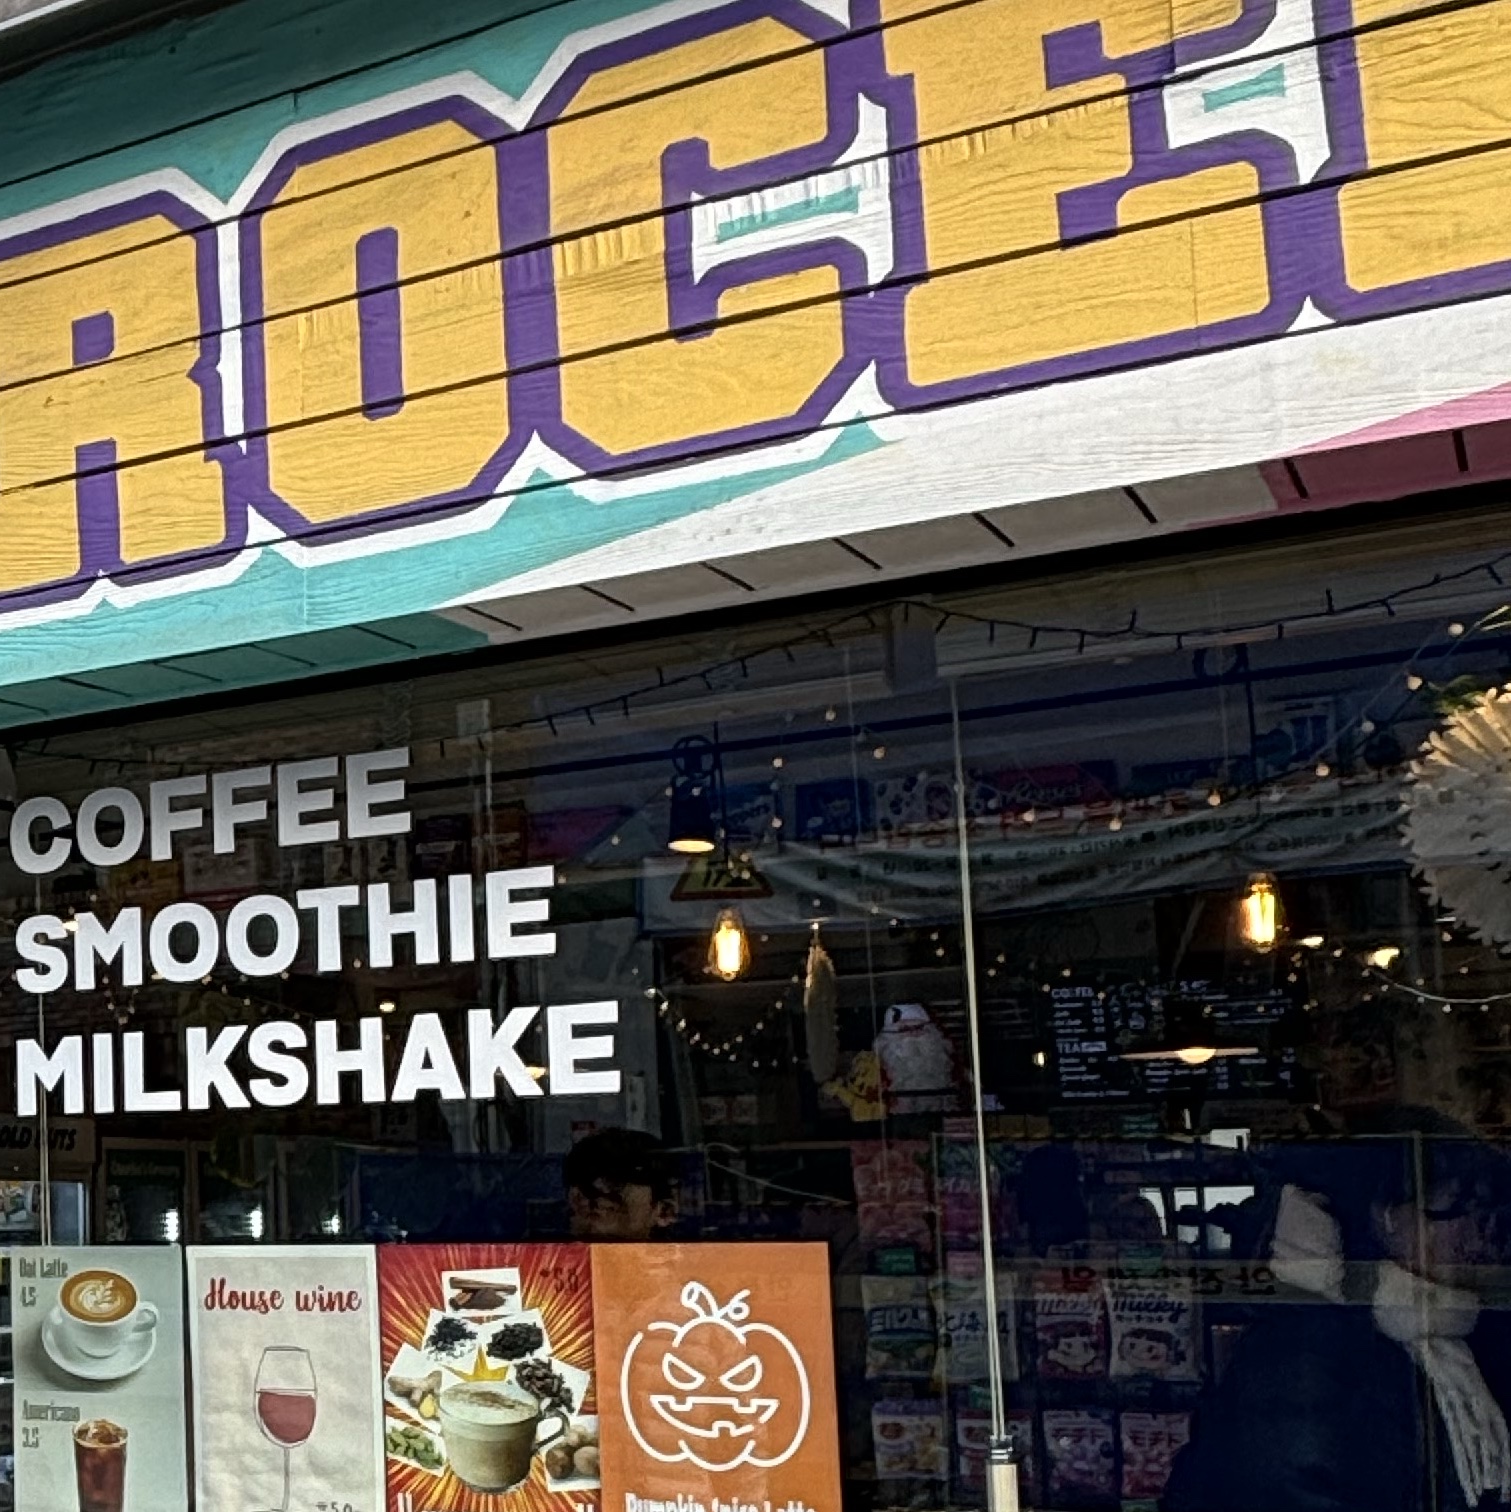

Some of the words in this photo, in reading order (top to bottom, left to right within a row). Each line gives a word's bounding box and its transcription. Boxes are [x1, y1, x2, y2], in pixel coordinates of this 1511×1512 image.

[8, 745, 411, 875] COFFEE
[13, 865, 559, 994] SMOOTHIE
[14, 1000, 623, 1117] MILKSHAKE
[39, 1256, 69, 1279] Latte
[204, 1277, 285, 1315] House
[295, 1284, 363, 1313] wine
